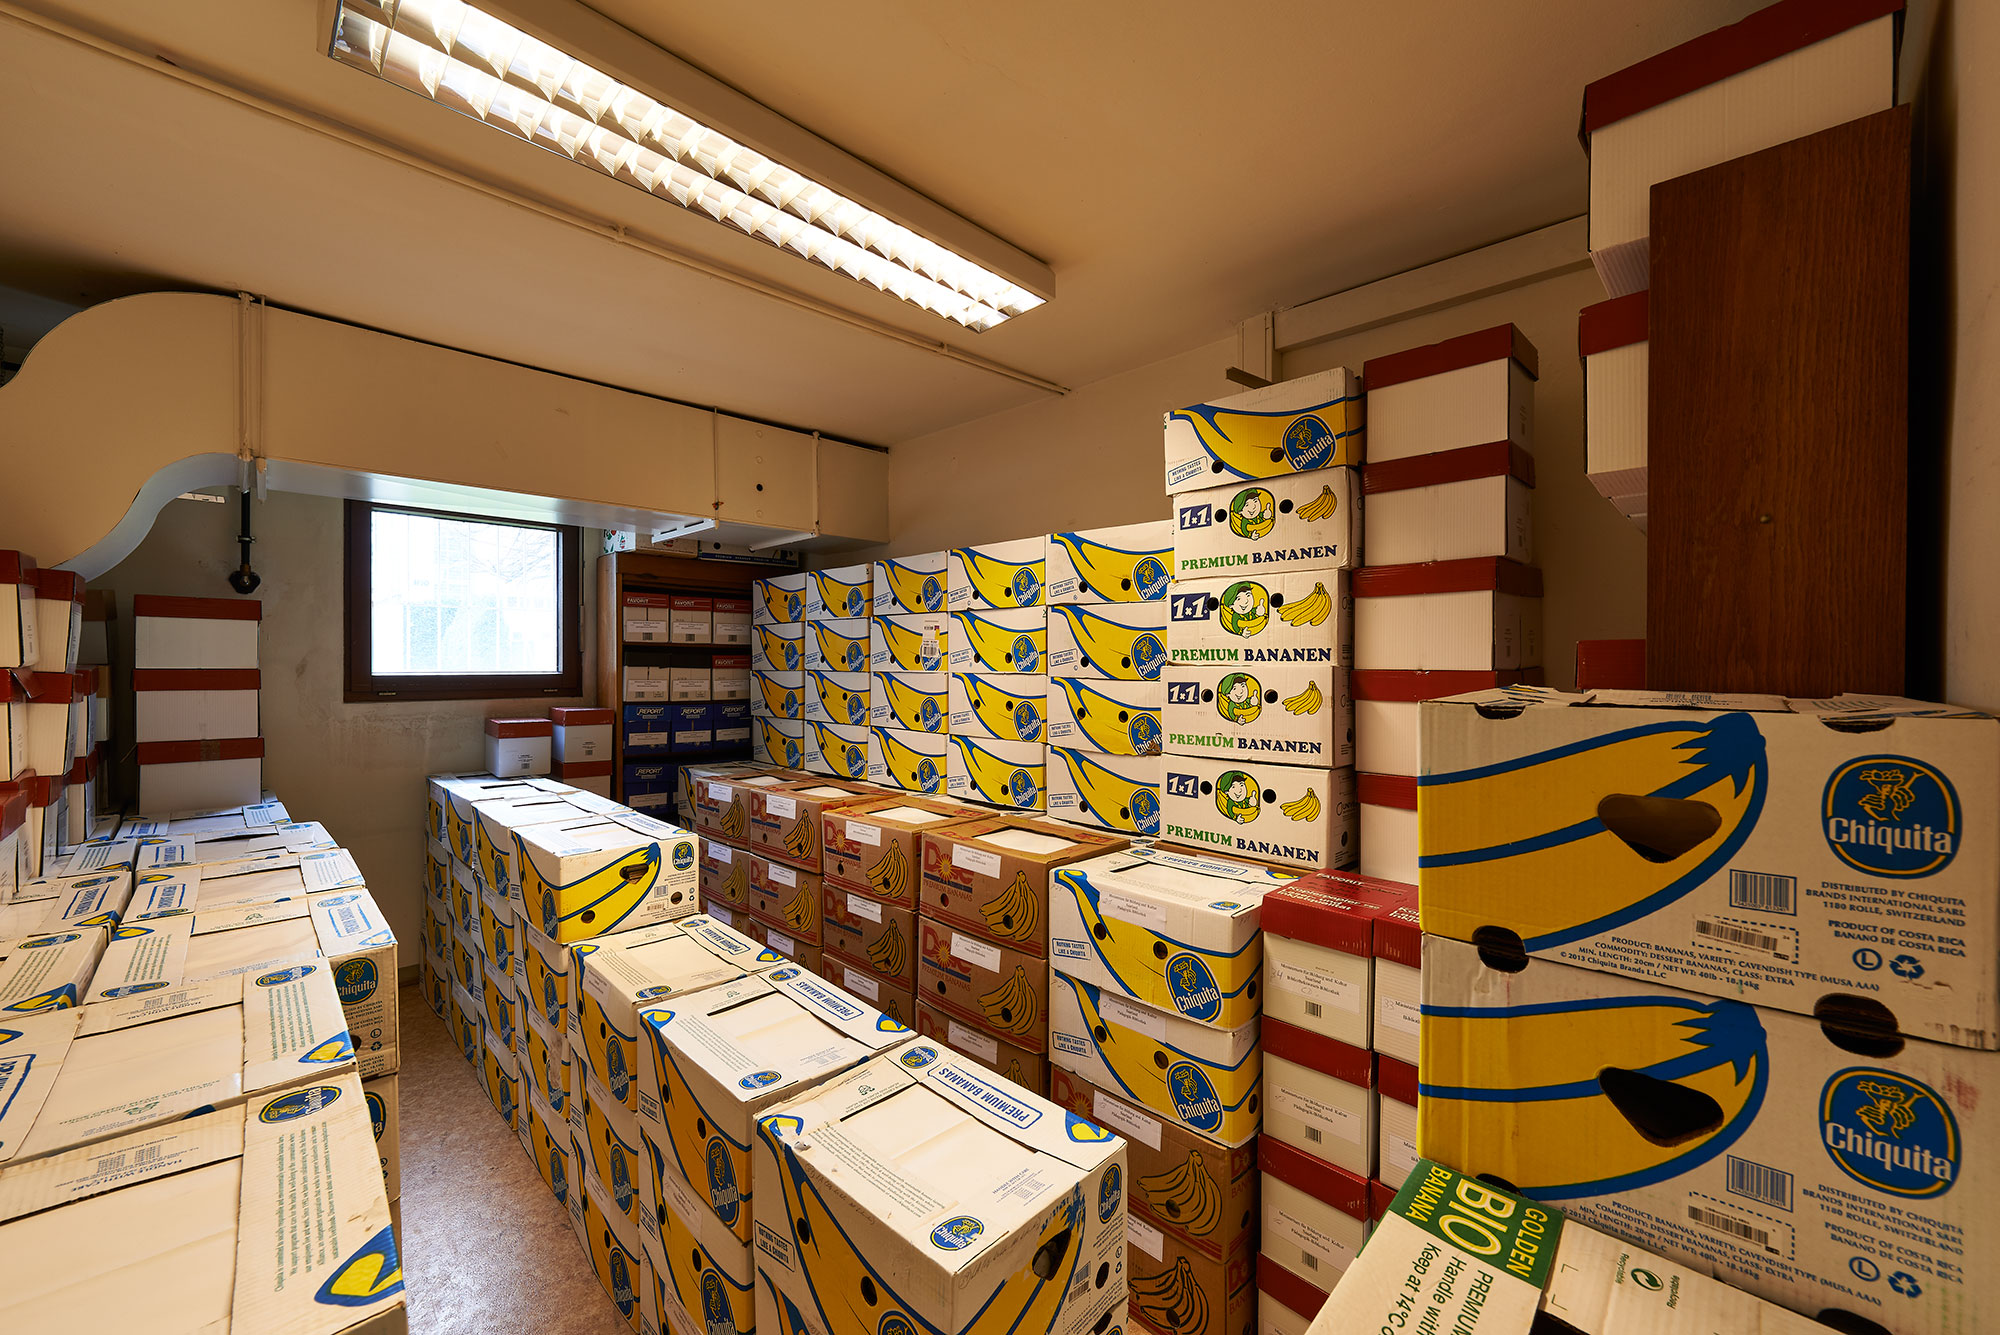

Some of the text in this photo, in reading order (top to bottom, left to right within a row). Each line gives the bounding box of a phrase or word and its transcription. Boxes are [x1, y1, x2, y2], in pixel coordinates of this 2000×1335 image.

[1292, 432, 1334, 472] Chiquita
[1181, 544, 1338, 571] PREMIUM BANANEN
[1017, 583, 1040, 605] Chiquita
[1140, 575, 1170, 600] Chiquita
[1016, 652, 1039, 670] Chiquita
[1138, 653, 1168, 676] Chiquita
[1171, 648, 1332, 662] PREMIUM BANANEN
[1019, 718, 1041, 738] Chiquita
[1169, 733, 1322, 755] PREMIUM BANANEN
[1015, 786, 1037, 806] Chiquita
[1166, 824, 1320, 863] PREMIUM BANANEN
[1829, 817, 1952, 855] Chiquita
[673, 856, 694, 866] Chiquita
[1316, 872, 1364, 886] FAVORIT
[1822, 881, 1966, 907] DISTRIBUTED BY CHIQUITA
[1806, 889, 1966, 917] BRANDS INTERNATIONAL SARL
[1823, 901, 1966, 927] 1180 ROLLE, SWITZERLAND
[1828, 920, 1966, 947] PRODUCT OF COSTA RICA
[1834, 930, 1966, 957] BANANO DE COSTA RICA
[1568, 952, 1668, 979] 2013 Chiquita Brands L.L.C
[1579, 947, 1760, 991] MIN. LENGTH: 20cm NET WT: 40lb 18.14kg
[1595, 942, 1795, 986] COMMODITY: DESSERT BANANAS, CLASS: EXTRA
[1612, 936, 1652, 950] PRODUCT:
[1655, 944, 1696, 959] BANANAS,
[1698, 952, 1736, 966] VARIETY:
[1738, 960, 1793, 976] CAVENDISH
[1794, 970, 1817, 981] TYPE
[1820, 974, 1852, 987] (MUSA
[1856, 981, 1880, 992] AAA)
[796, 982, 854, 1016] PREMIUM BANANAS
[1175, 986, 1219, 1012] Chiquita
[938, 1067, 1030, 1122] PREMIUM BANANAS
[1178, 1098, 1220, 1120] Chiquita
[1826, 1122, 1952, 1181] Chiquita
[711, 1186, 739, 1210] Chiquita
[1405, 1166, 1453, 1222] BANANA
[1818, 1184, 1964, 1235] DISTRIBUTED BY CHIQUITA
[1438, 1178, 1517, 1256] BIO
[1803, 1188, 1964, 1246] BRANDS INTERNATIONAL SARL
[1820, 1204, 1964, 1256] 1180 ROLLE, SWITZERLAND
[935, 1226, 967, 1250] Chiquita
[1506, 1207, 1548, 1278] GOLDEN
[1596, 1203, 1795, 1283] COMMODITY: DESSERT BANANAS, CLASS: EXTRA
[1612, 1200, 1652, 1220] PRODUCT:
[1656, 1216, 1697, 1238] BANANAS,
[1699, 1232, 1736, 1252] VARIETY:
[1738, 1247, 1792, 1272] CAVENDISH
[1794, 1267, 1817, 1282] TYPE
[1820, 1278, 1853, 1296] (MUSA
[1856, 1292, 1882, 1306] AAA)
[1824, 1222, 1964, 1274] PRODUCT OF COSTA RICA
[1412, 1242, 1442, 1275] Keep
[1614, 1253, 1630, 1284] Recyclable
[1830, 1234, 1964, 1284] BANANO DE COSTA RICA
[1405, 1274, 1421, 1293] at
[1432, 1256, 1468, 1304] Handle
[1666, 1274, 1681, 1310] Recyclable
